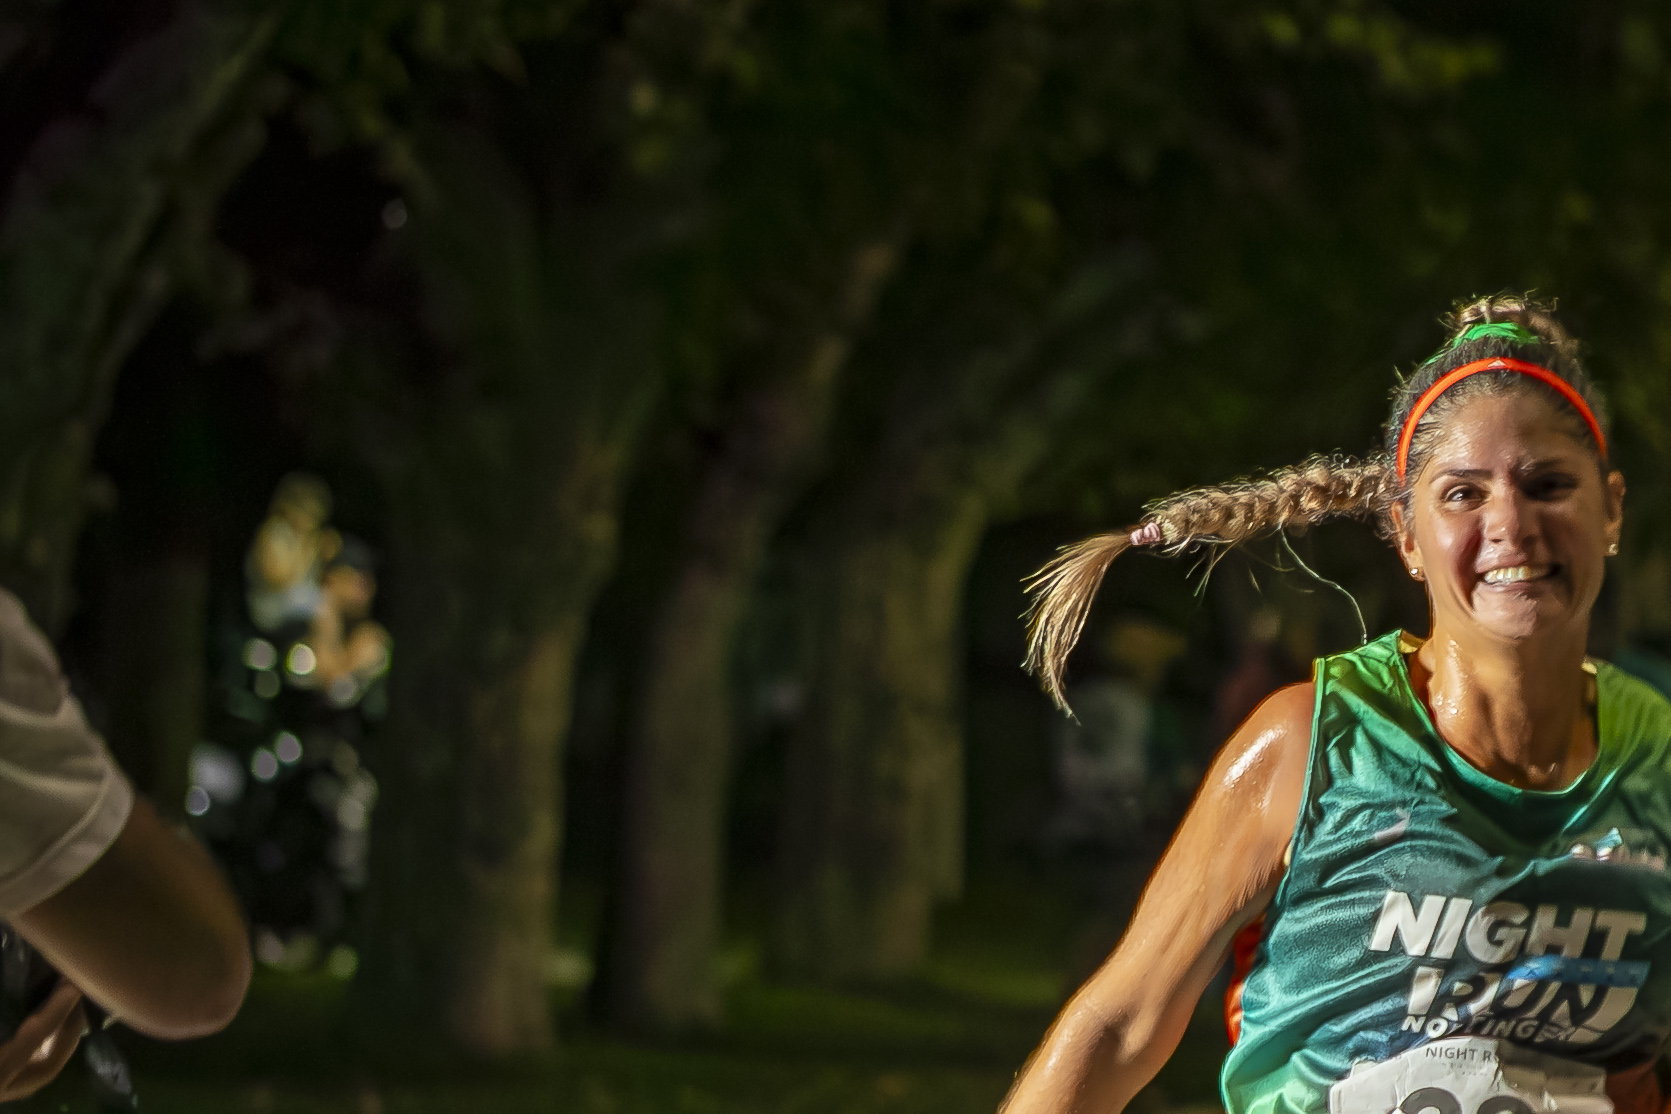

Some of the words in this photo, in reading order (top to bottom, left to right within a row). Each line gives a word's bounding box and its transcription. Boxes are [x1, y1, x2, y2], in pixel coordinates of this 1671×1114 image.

[1370, 890, 1647, 964] NIGHT
[1407, 966, 1639, 1032] RUN
[1426, 1046, 1478, 1061] NIGHT
